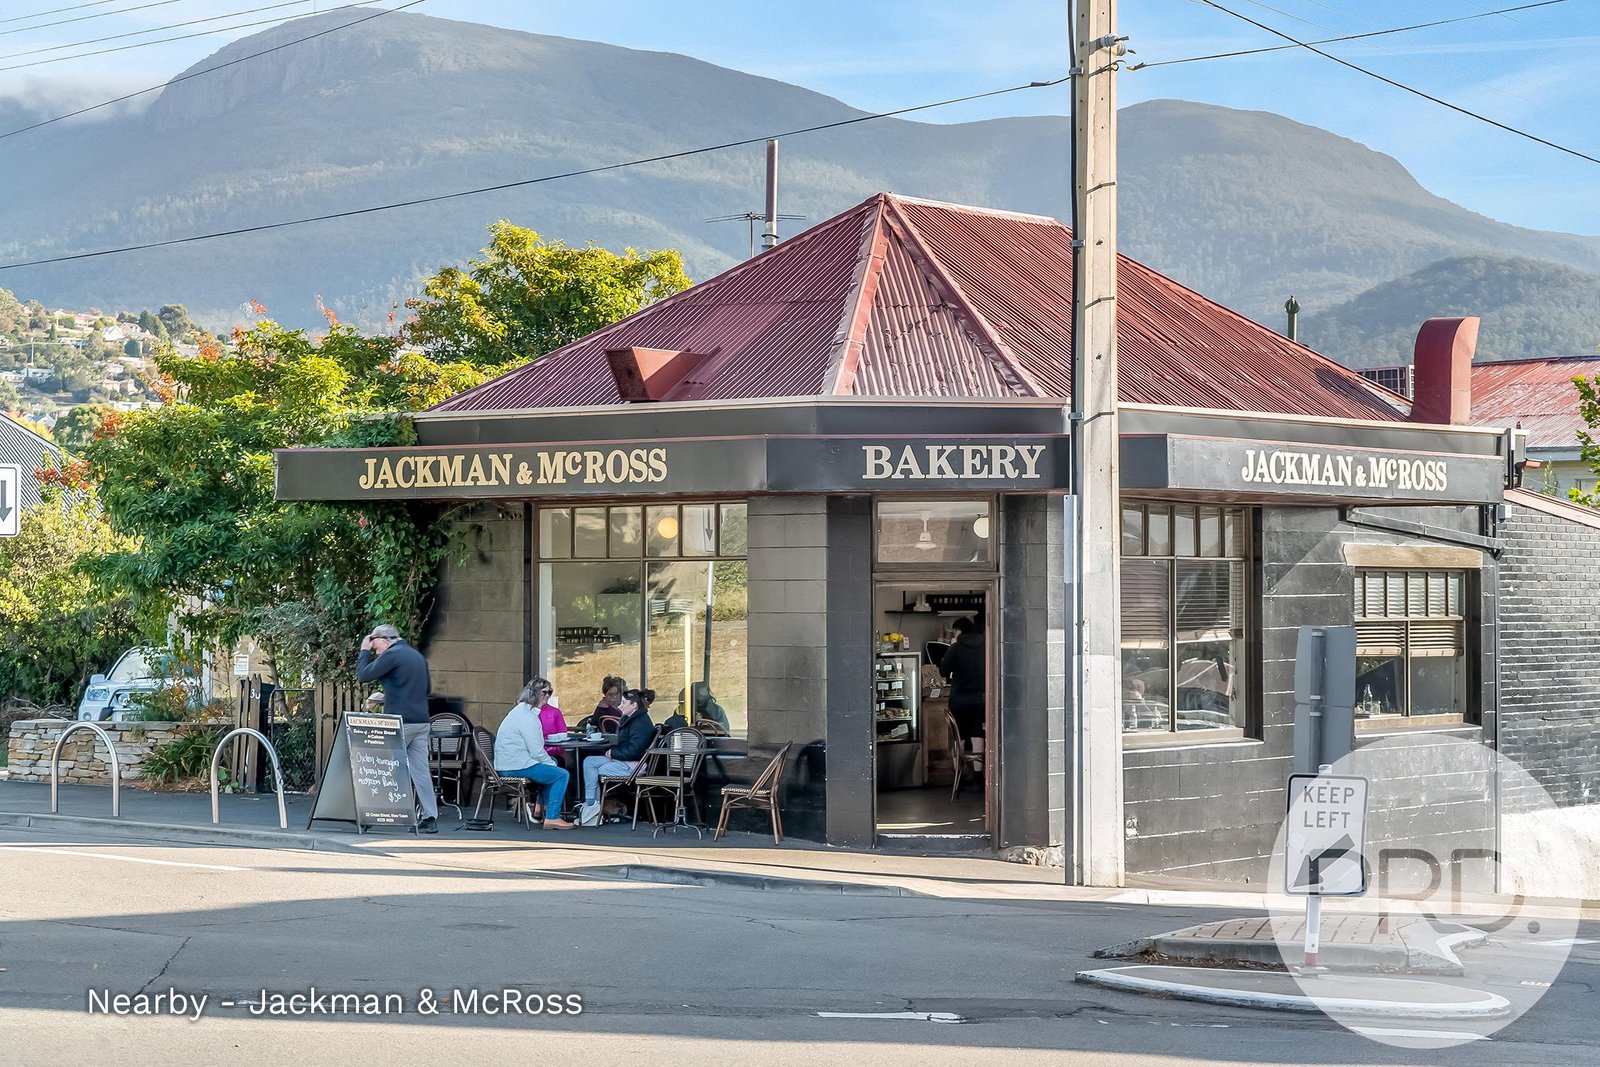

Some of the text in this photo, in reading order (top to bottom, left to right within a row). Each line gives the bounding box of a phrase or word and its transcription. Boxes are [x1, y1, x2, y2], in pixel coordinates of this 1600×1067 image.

[358, 453, 513, 490] JACKMAN
[516, 461, 533, 485] &
[862, 444, 1046, 479] BAKERY
[1241, 449, 1354, 486] JACKMAN
[1354, 464, 1367, 487] &
[1303, 785, 1355, 804] KEEP
[1303, 810, 1351, 829] LEFT
